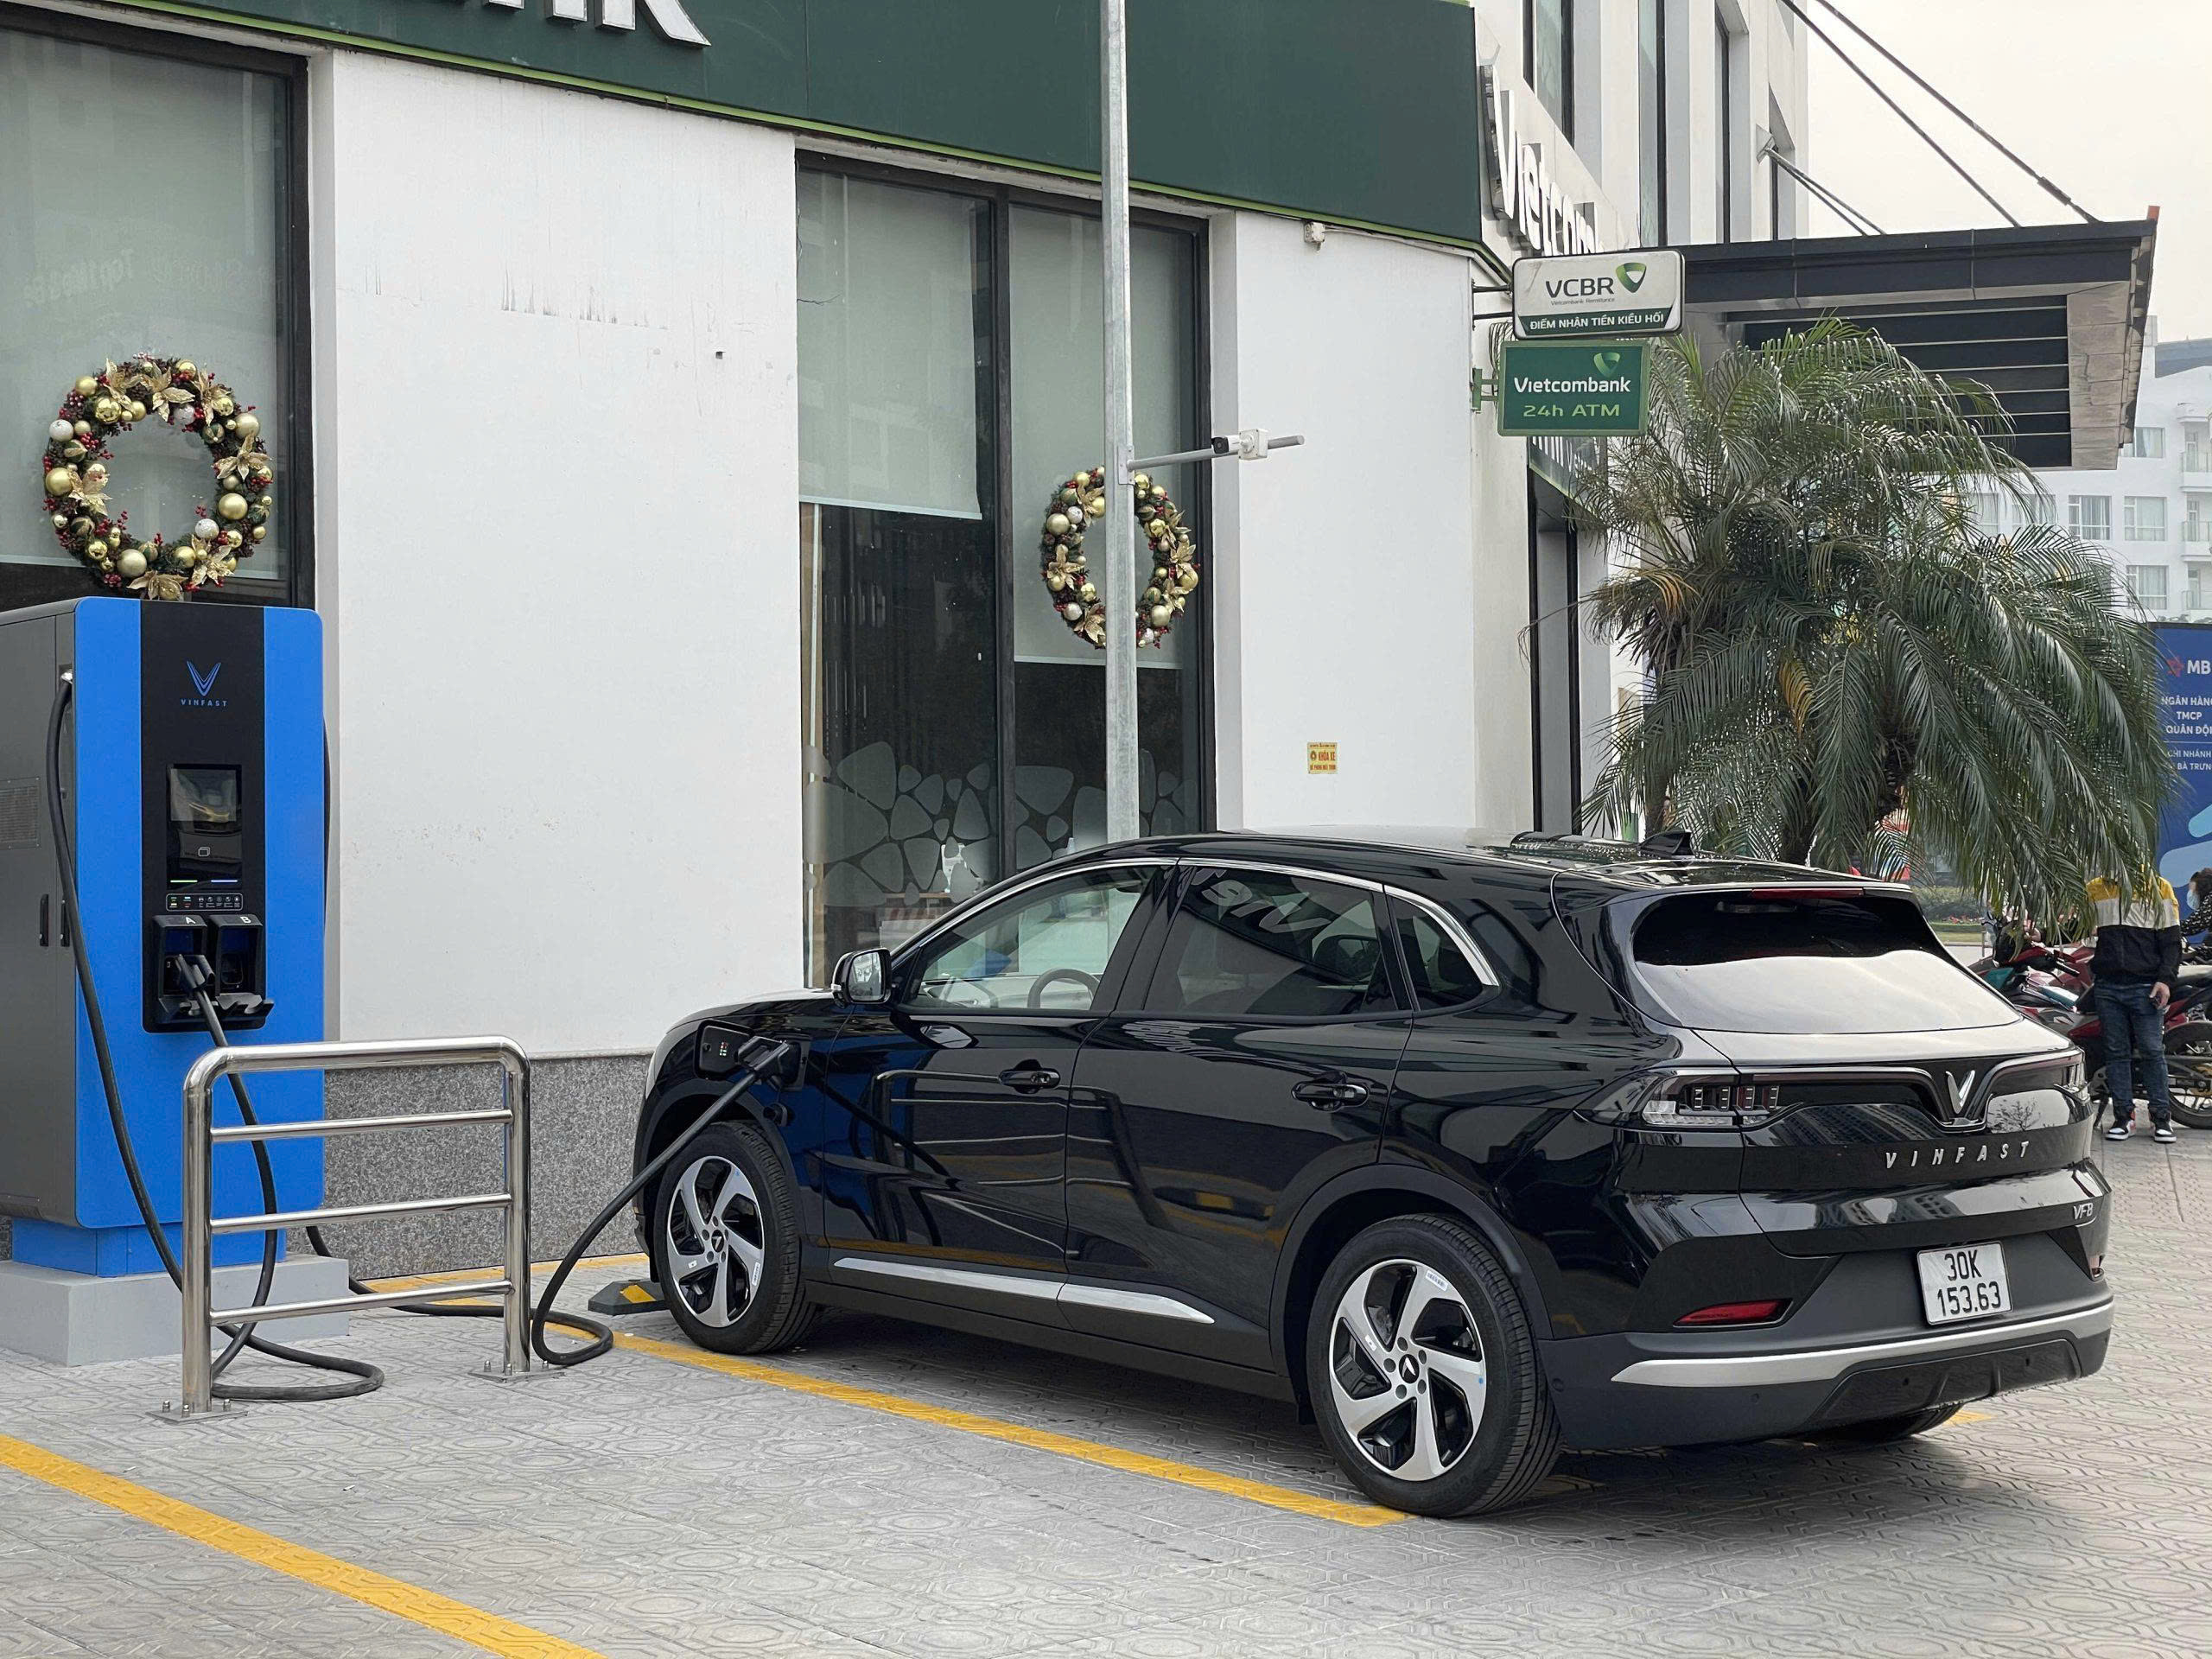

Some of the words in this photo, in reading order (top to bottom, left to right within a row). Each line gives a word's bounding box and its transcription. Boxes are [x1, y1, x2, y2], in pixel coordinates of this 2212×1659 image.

[1546, 277, 1614, 298] VCBR
[1559, 316, 1589, 329] NHẬN
[1645, 311, 1664, 322] HỐI
[1514, 376, 1631, 393] Vietcombank
[1523, 404, 1564, 417] 24h
[1572, 404, 1620, 416] ATM
[2187, 659, 2211, 675] MB
[2161, 695, 2189, 706] NGÂN
[2190, 696, 2212, 706] HÀN
[2177, 711, 2202, 720] TMCP
[2166, 723, 2193, 734] QUÂN
[2183, 748, 2212, 758] NHÁNH
[185, 916, 196, 925] A
[1885, 1141, 2029, 1169] VINFAST
[1944, 1249, 1982, 1281] 30K
[1937, 1281, 2001, 1317] 153.63
